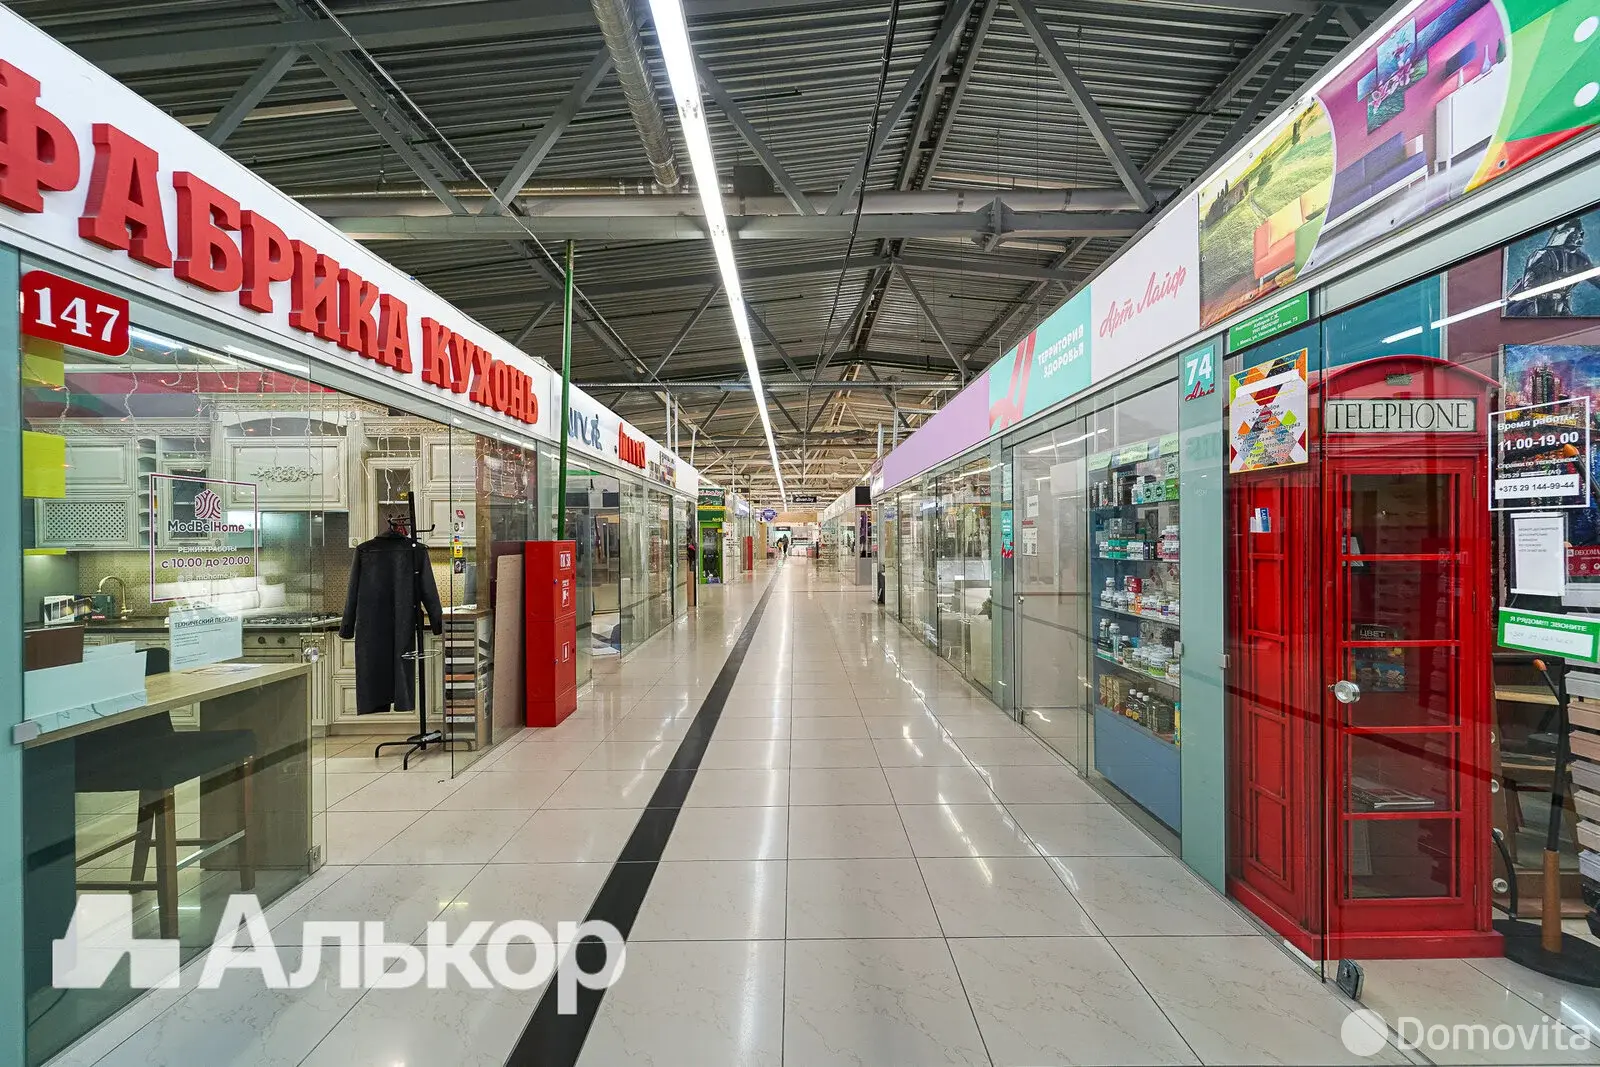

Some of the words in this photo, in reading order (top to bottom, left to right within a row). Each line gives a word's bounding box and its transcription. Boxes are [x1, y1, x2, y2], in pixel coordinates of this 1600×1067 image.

[0, 59, 412, 374] ФАБРИКА
[421, 317, 538, 424] КУХОНЬ
[1100, 298, 1134, 338] Арт
[1137, 265, 1186, 314] Лайф
[34, 287, 120, 342] 147
[1038, 324, 1084, 366] ТЕРРИТОРИЯ
[1044, 342, 1084, 378] ЗДОРОВЬЯ
[1186, 353, 1212, 386] 74
[1329, 403, 1469, 429] TELEPHONE
[1497, 420, 1531, 432] Время
[1532, 413, 1579, 428] работы:
[1498, 431, 1579, 451] 11.00-19.00
[1499, 484, 1518, 493] +375
[1519, 484, 1530, 492] 29
[1532, 481, 1575, 491] 144-99-44
[168, 520, 245, 533] ModBelHome
[161, 561, 169, 569] с
[172, 558, 202, 568] 10.00
[206, 558, 220, 568] до
[222, 556, 250, 566] 20.00
[174, 617, 214, 629] ТЕХНИЧЕСКИЙ
[1550, 621, 1588, 632] ЗВОНИТЕ
[1359, 630, 1386, 639] ЦВЕТ
